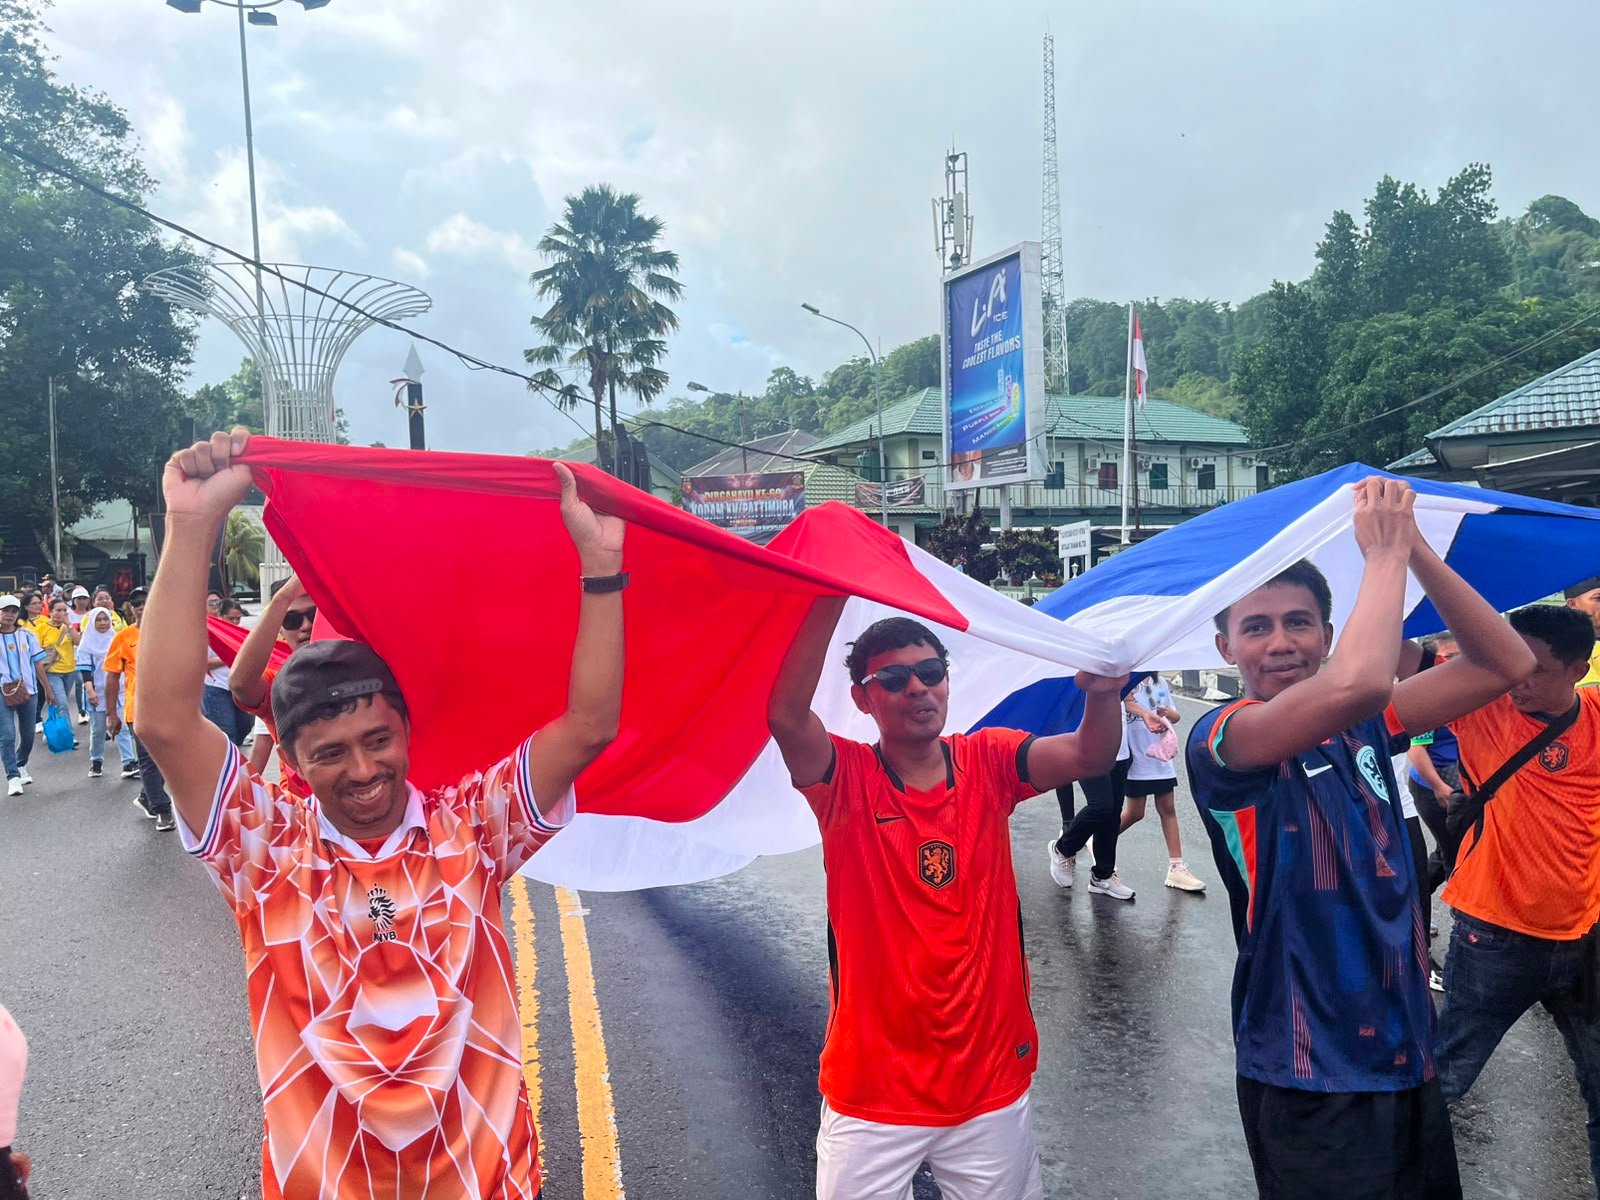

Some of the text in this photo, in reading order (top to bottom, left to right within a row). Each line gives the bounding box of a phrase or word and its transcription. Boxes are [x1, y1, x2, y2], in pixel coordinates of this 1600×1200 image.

[993, 311, 1008, 323] ICE
[974, 330, 1003, 353] TASTE THE
[962, 335, 1021, 370] COOLEST FLAVORS
[704, 490, 754, 502] DIRGAHAYU
